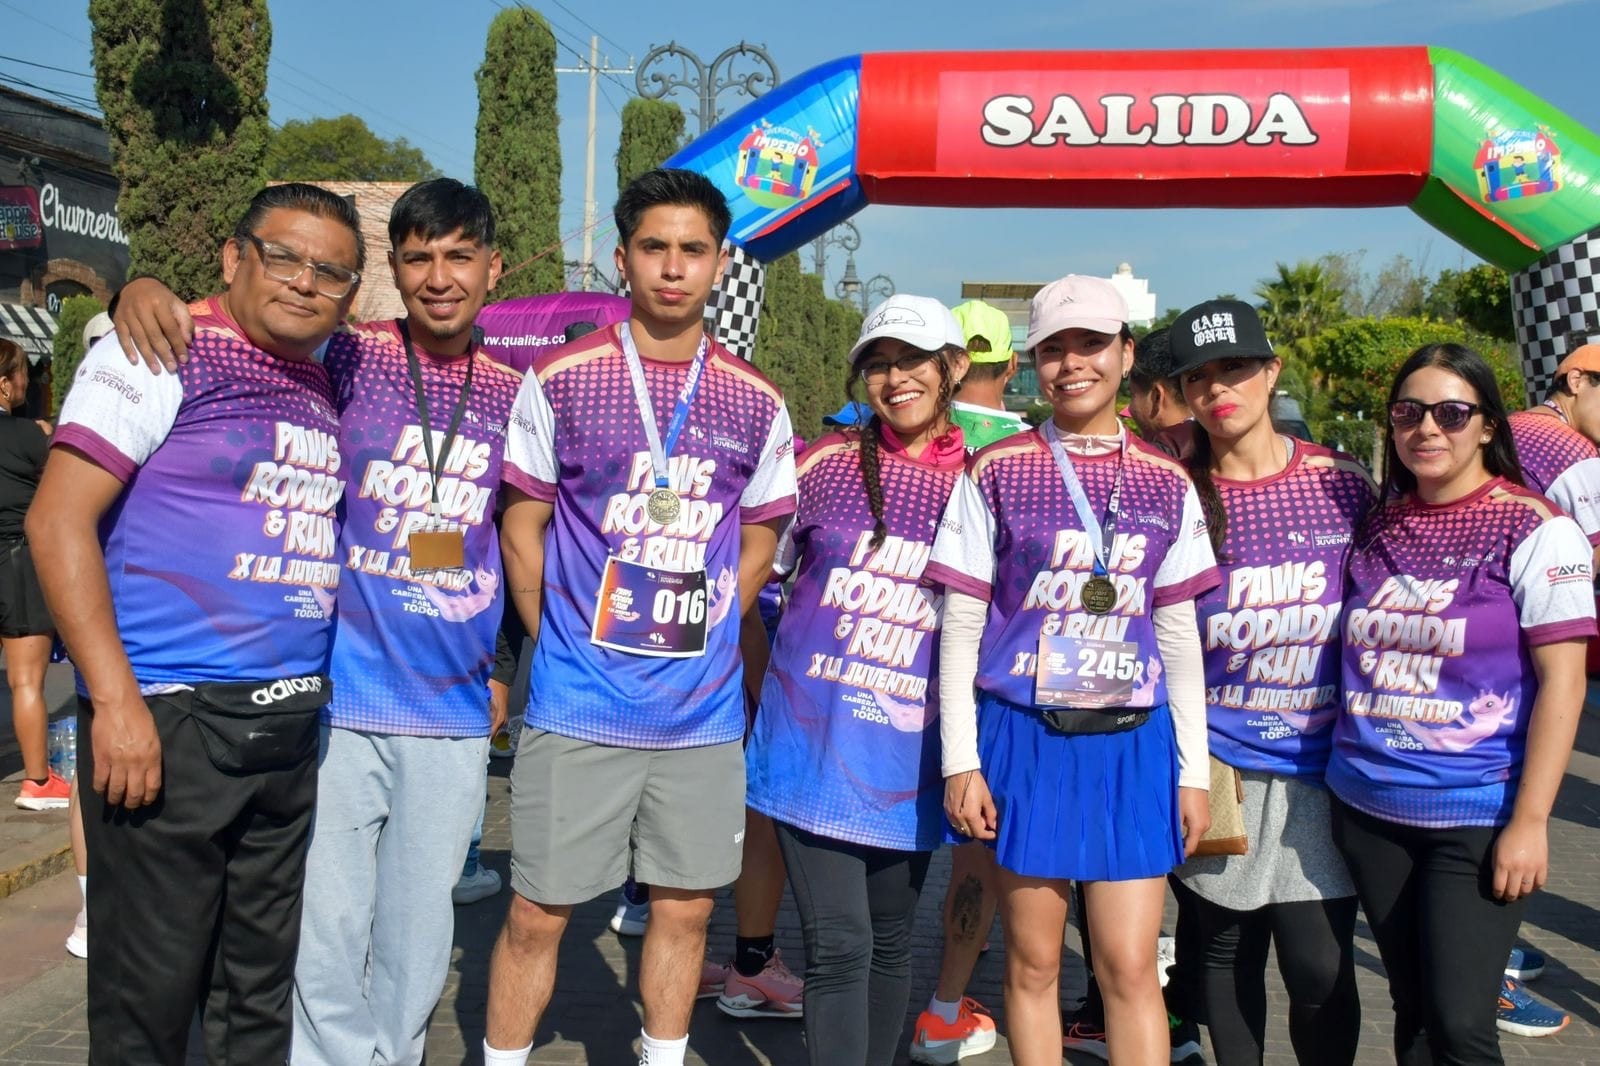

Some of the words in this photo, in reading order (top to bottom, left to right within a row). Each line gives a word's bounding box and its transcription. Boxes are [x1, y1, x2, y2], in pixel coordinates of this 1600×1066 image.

[980, 92, 1320, 148] SALIDA
[753, 135, 810, 157] IMPERIO
[1191, 312, 1234, 333] CASH
[1194, 327, 1237, 347] ONLY
[90, 374, 141, 405] JUVENTUD
[274, 421, 342, 474] PAWS
[241, 461, 347, 518] RODADA
[358, 459, 493, 525] RODADA
[263, 509, 287, 537] &
[283, 511, 337, 559] RUN
[374, 507, 400, 534] &
[347, 545, 366, 570] X
[361, 549, 390, 575] LA
[620, 538, 642, 561] &
[640, 535, 708, 572] RUN
[848, 530, 932, 580] PAW
[229, 552, 256, 580] X
[251, 555, 283, 583] LA
[279, 559, 341, 588] JUVENT
[1227, 560, 1327, 609] PAWS
[652, 588, 706, 625] 016
[1367, 574, 1460, 614] PAWS
[293, 608, 324, 619] TODOS
[402, 602, 440, 617] TODOS
[834, 613, 854, 640] &
[846, 617, 926, 668] RUN
[1040, 613, 1062, 637] &
[1062, 612, 1131, 642] RUN
[1347, 608, 1467, 657] RODADA
[807, 652, 827, 679] X
[822, 656, 844, 680] LA
[840, 662, 928, 701] JUVENTUD
[1009, 652, 1031, 677] X
[1077, 648, 1137, 681] 245
[1226, 652, 1248, 673] &
[1246, 645, 1322, 687] RUN
[1359, 650, 1377, 675] &
[1373, 651, 1444, 695] RUN
[251, 676, 321, 705] adidas
[842, 694, 877, 708] CARRERA
[857, 691, 873, 700] UNA
[1205, 686, 1222, 705] X
[1220, 684, 1245, 708] LA
[1247, 683, 1337, 712] JUVENTUD
[852, 708, 889, 725] TODOS
[860, 705, 882, 716] PARA
[1262, 714, 1280, 722] UNA
[1352, 691, 1373, 716] LA
[1371, 693, 1464, 724] JUVENTUD
[1247, 719, 1284, 728] CARRERA
[1259, 730, 1299, 740] TODOS
[1269, 726, 1291, 734] PARA
[1385, 737, 1424, 751] TODOS
